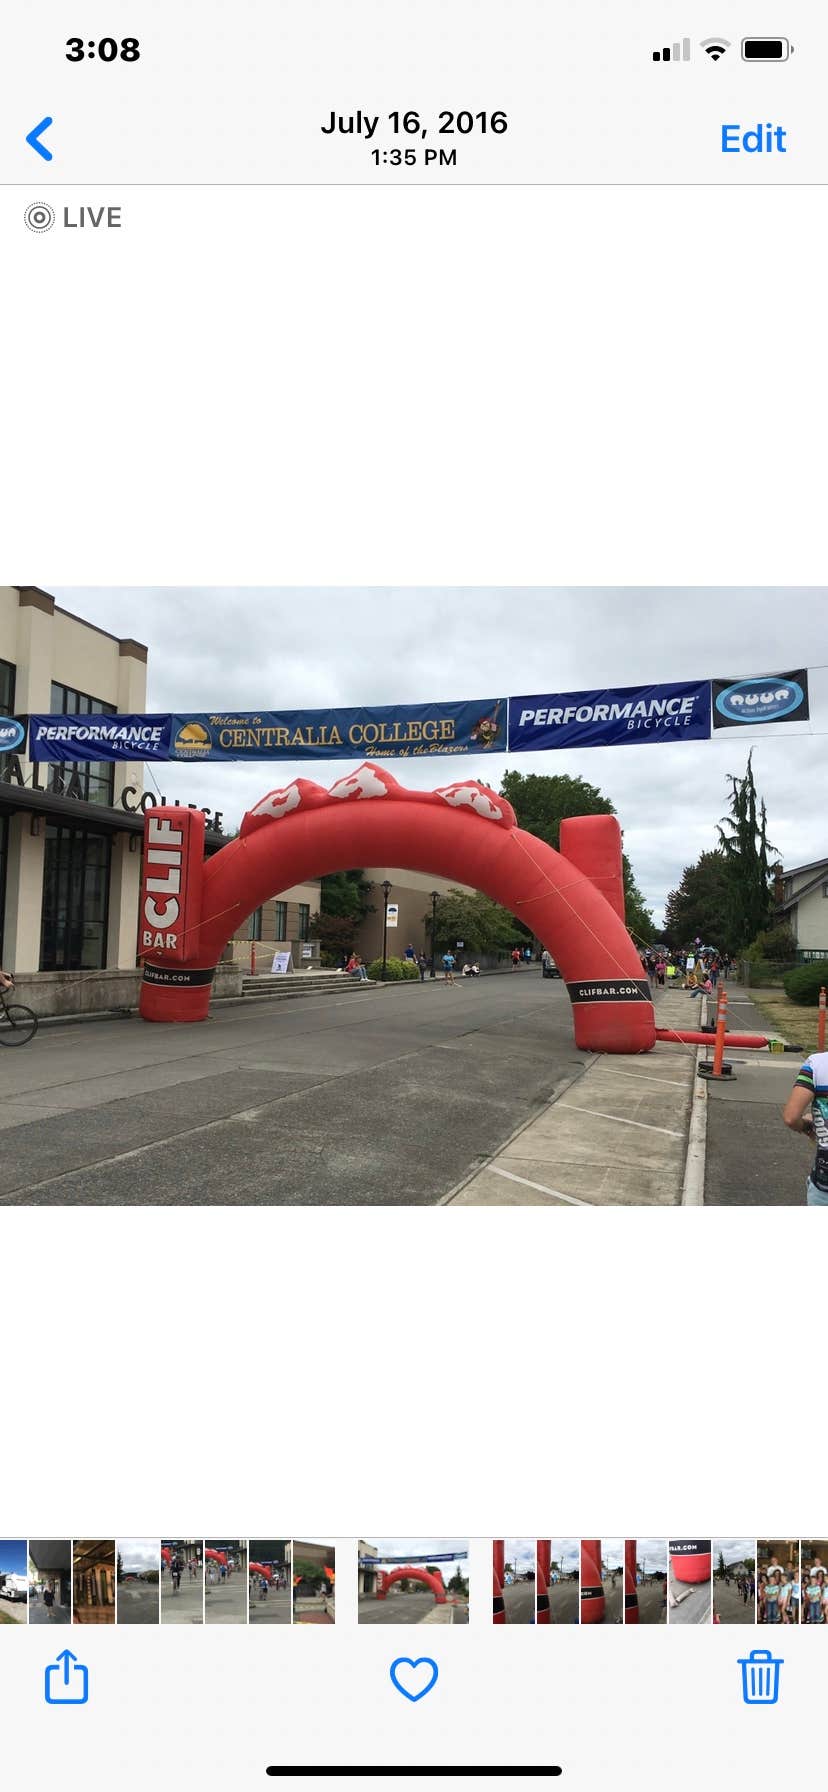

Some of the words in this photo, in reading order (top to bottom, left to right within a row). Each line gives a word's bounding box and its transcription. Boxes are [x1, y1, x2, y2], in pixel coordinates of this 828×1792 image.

[518, 697, 695, 727] PERFORMANCE
[209, 715, 250, 727] Welcome
[252, 716, 262, 725] to
[627, 714, 692, 730] BICYCLE
[36, 726, 162, 741] PERFORMANCE
[219, 725, 343, 748] CENTRALIA
[349, 720, 455, 744] COLLEGE
[112, 741, 160, 751] BICYCLE
[365, 745, 396, 758] Home
[399, 745, 412, 758] of
[413, 744, 429, 755] the
[429, 743, 469, 754] Blazers
[121, 786, 224, 832] COGE
[145, 817, 182, 929] CLIF
[143, 931, 177, 949] BAR
[579, 985, 638, 997] CLIFBAR.COM
